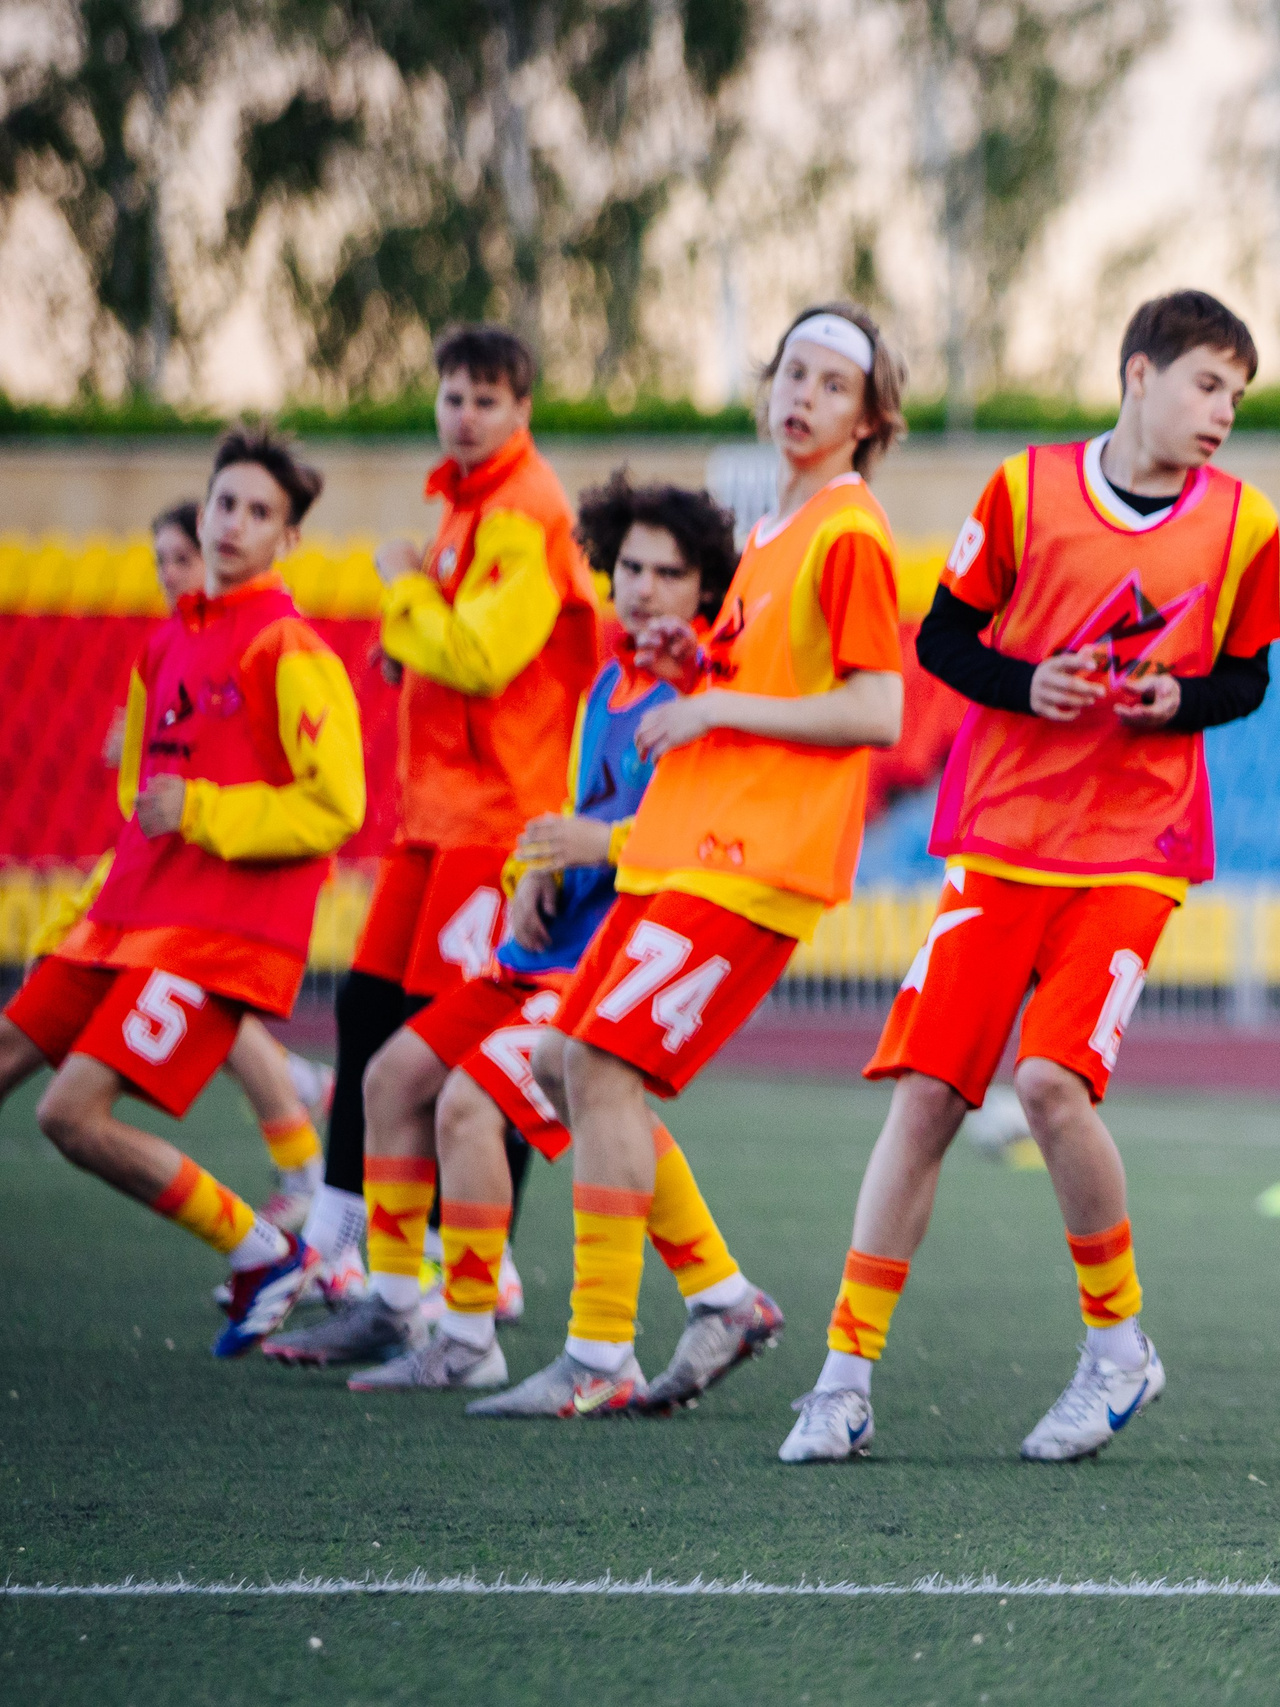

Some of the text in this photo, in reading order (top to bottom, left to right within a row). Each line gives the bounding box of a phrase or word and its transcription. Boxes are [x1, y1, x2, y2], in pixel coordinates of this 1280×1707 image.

[438, 885, 516, 984] 4
[595, 919, 732, 1055] 74
[121, 967, 209, 1067] 5
[479, 989, 562, 1123] 2
